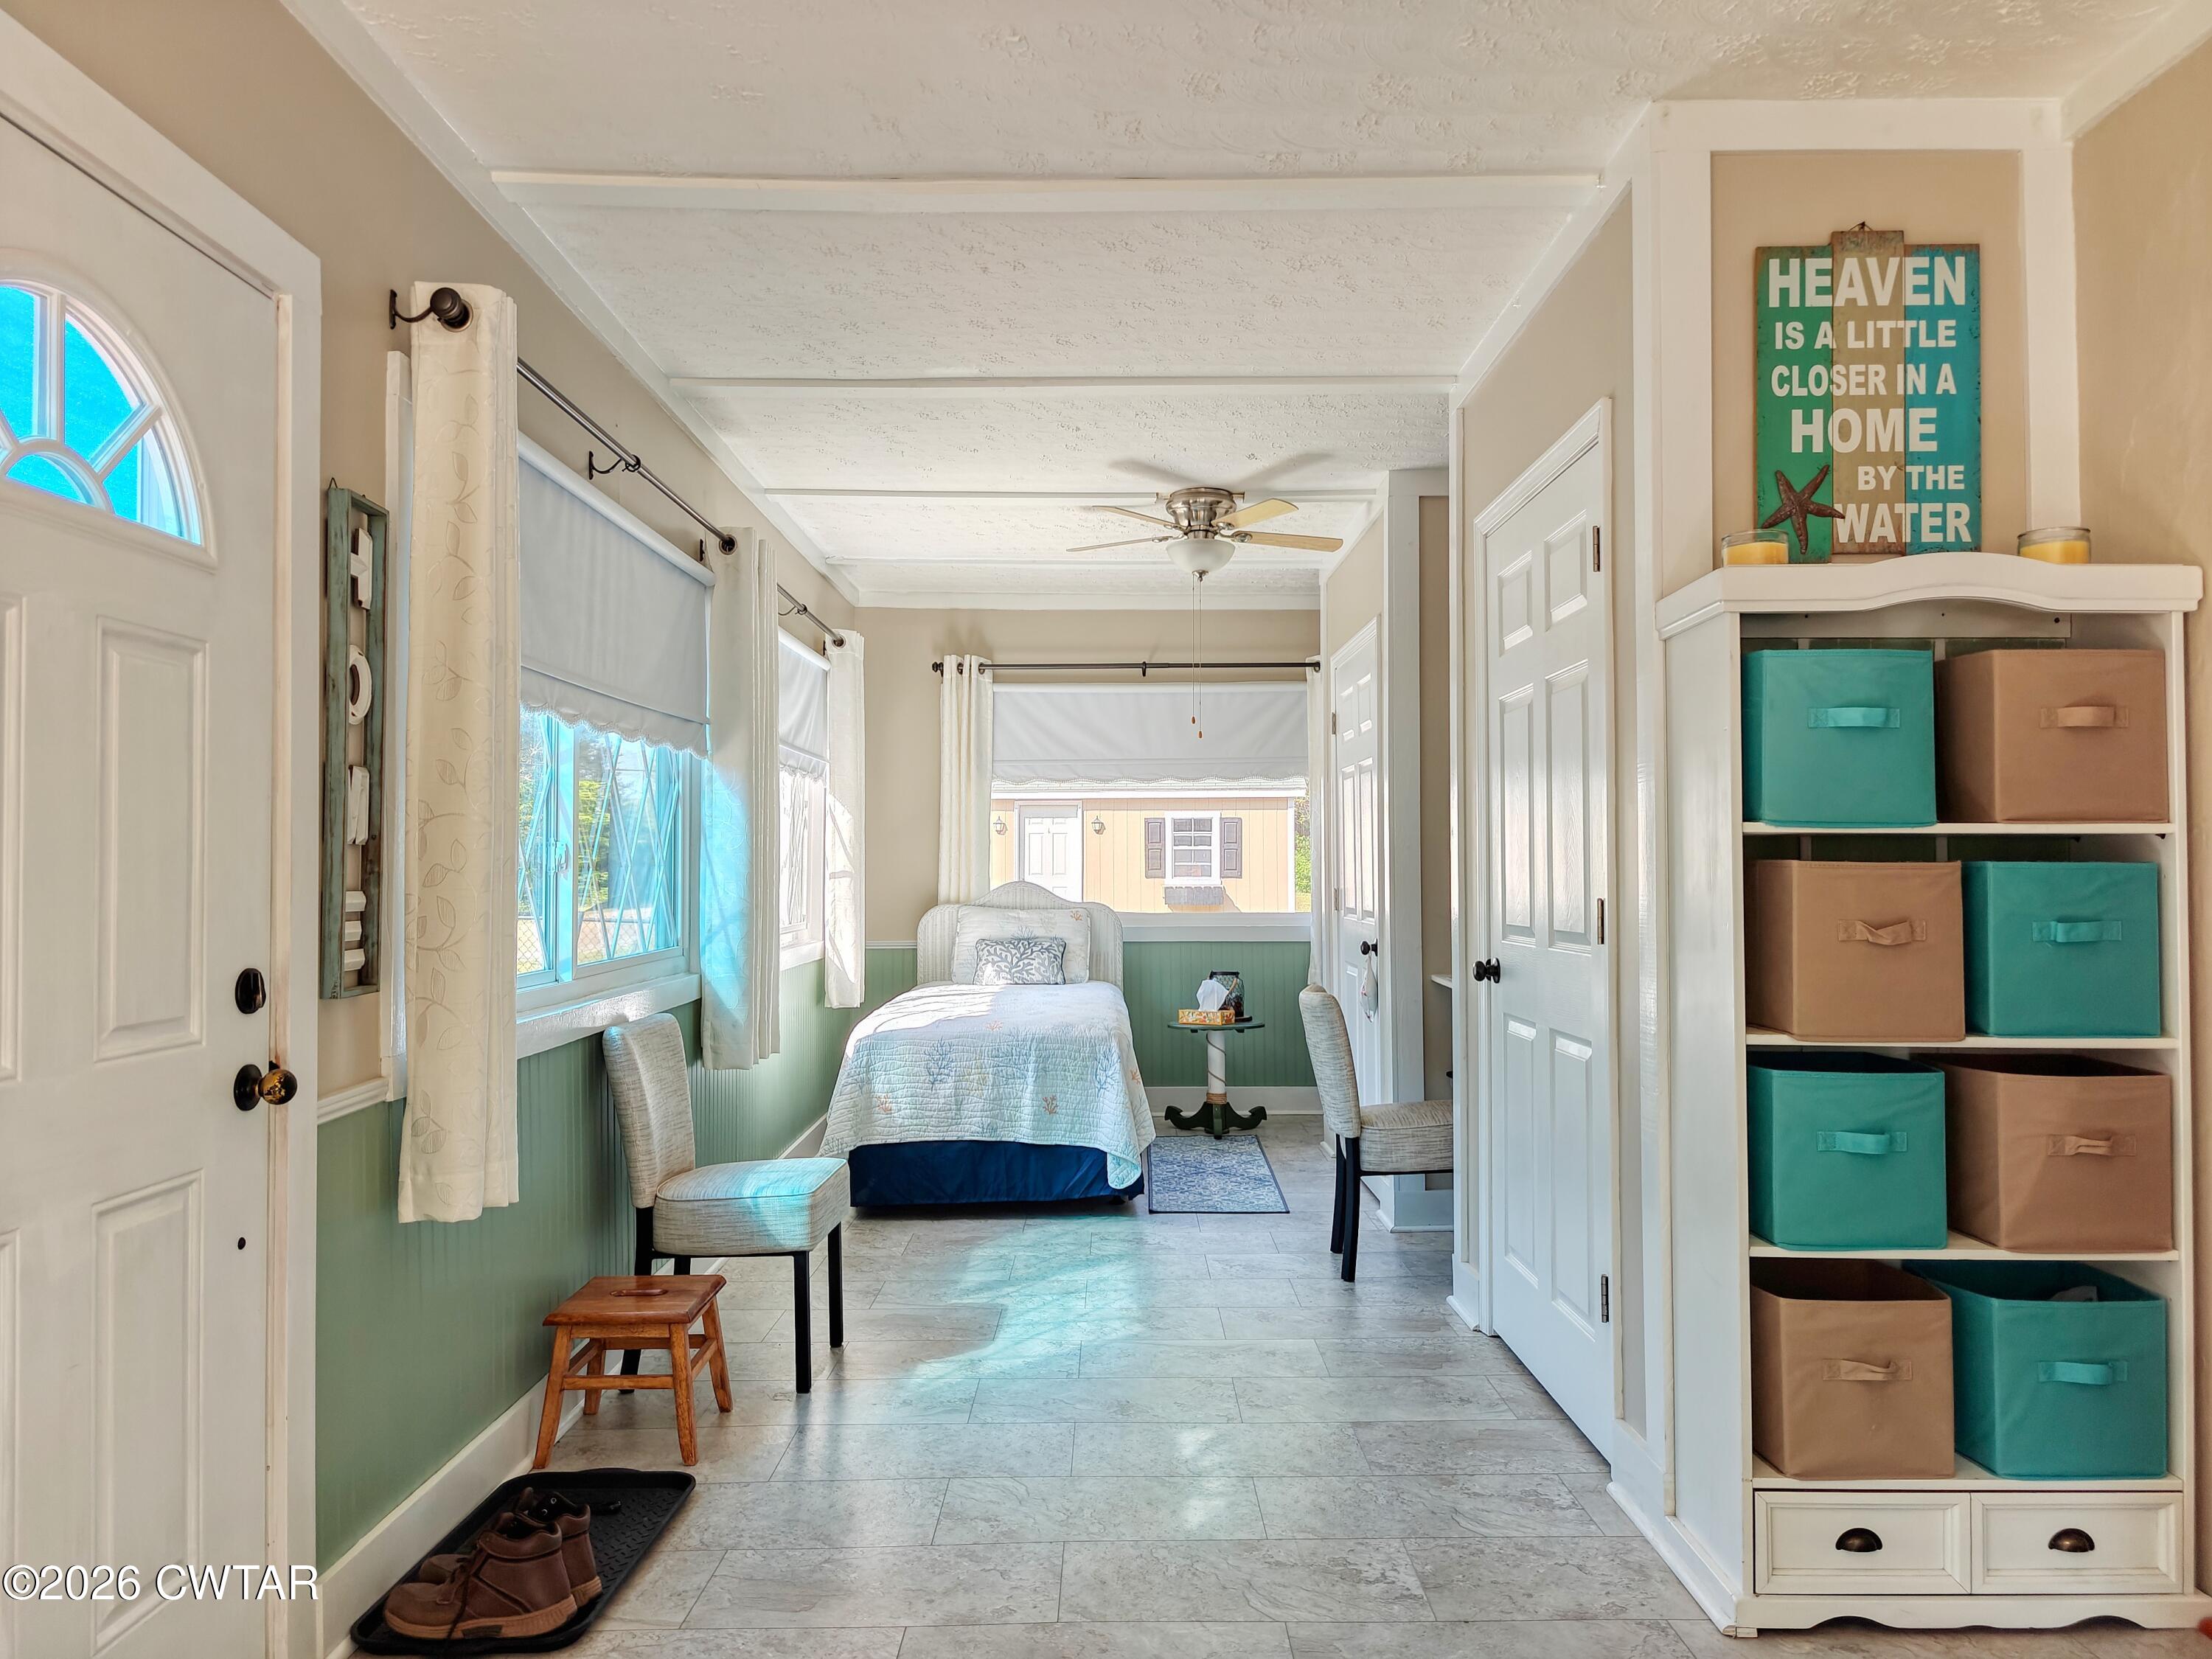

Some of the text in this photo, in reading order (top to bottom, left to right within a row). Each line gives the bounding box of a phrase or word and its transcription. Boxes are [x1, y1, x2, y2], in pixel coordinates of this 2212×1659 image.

[1768, 257, 1966, 307] HEAVEN
[1775, 320, 1957, 349] IS A LITTLE
[1771, 363, 1958, 397] CLOSER IN A
[1791, 408, 1938, 453] HOME
[1857, 465, 1965, 490] BY THE
[1834, 502, 1972, 543] WATER
